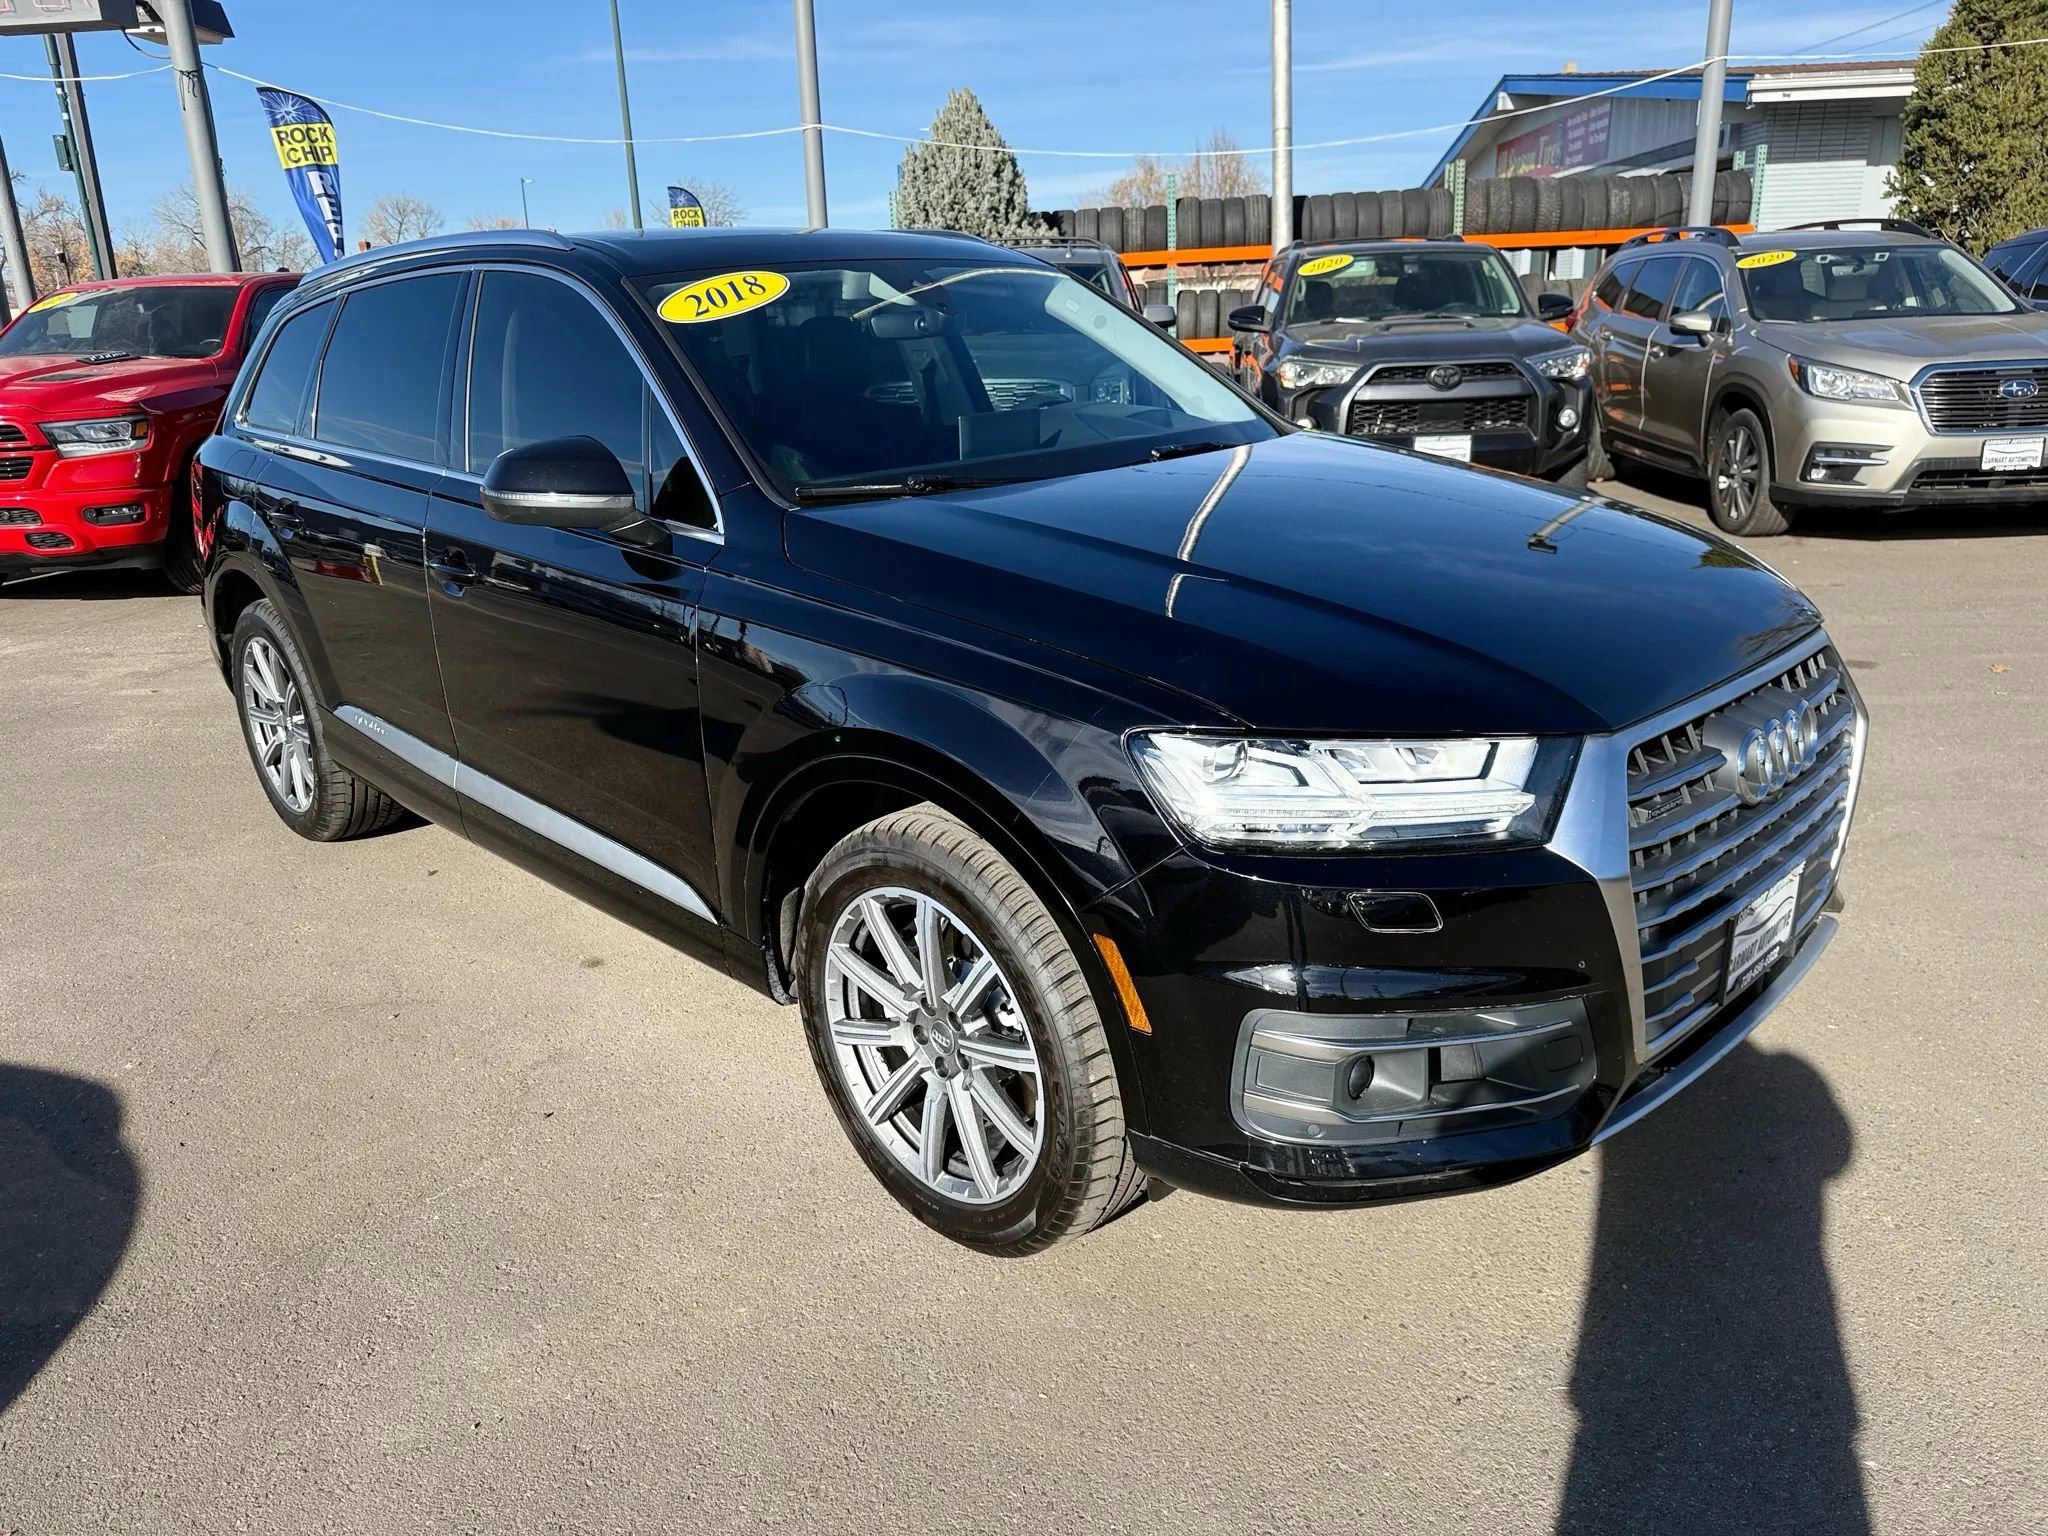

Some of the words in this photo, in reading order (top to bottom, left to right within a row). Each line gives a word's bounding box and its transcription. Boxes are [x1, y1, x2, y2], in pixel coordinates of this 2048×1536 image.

[275, 127, 333, 146] ROCK
[286, 145, 333, 164] CHIP
[673, 209, 700, 219] ROCK
[684, 274, 767, 317] 2018
